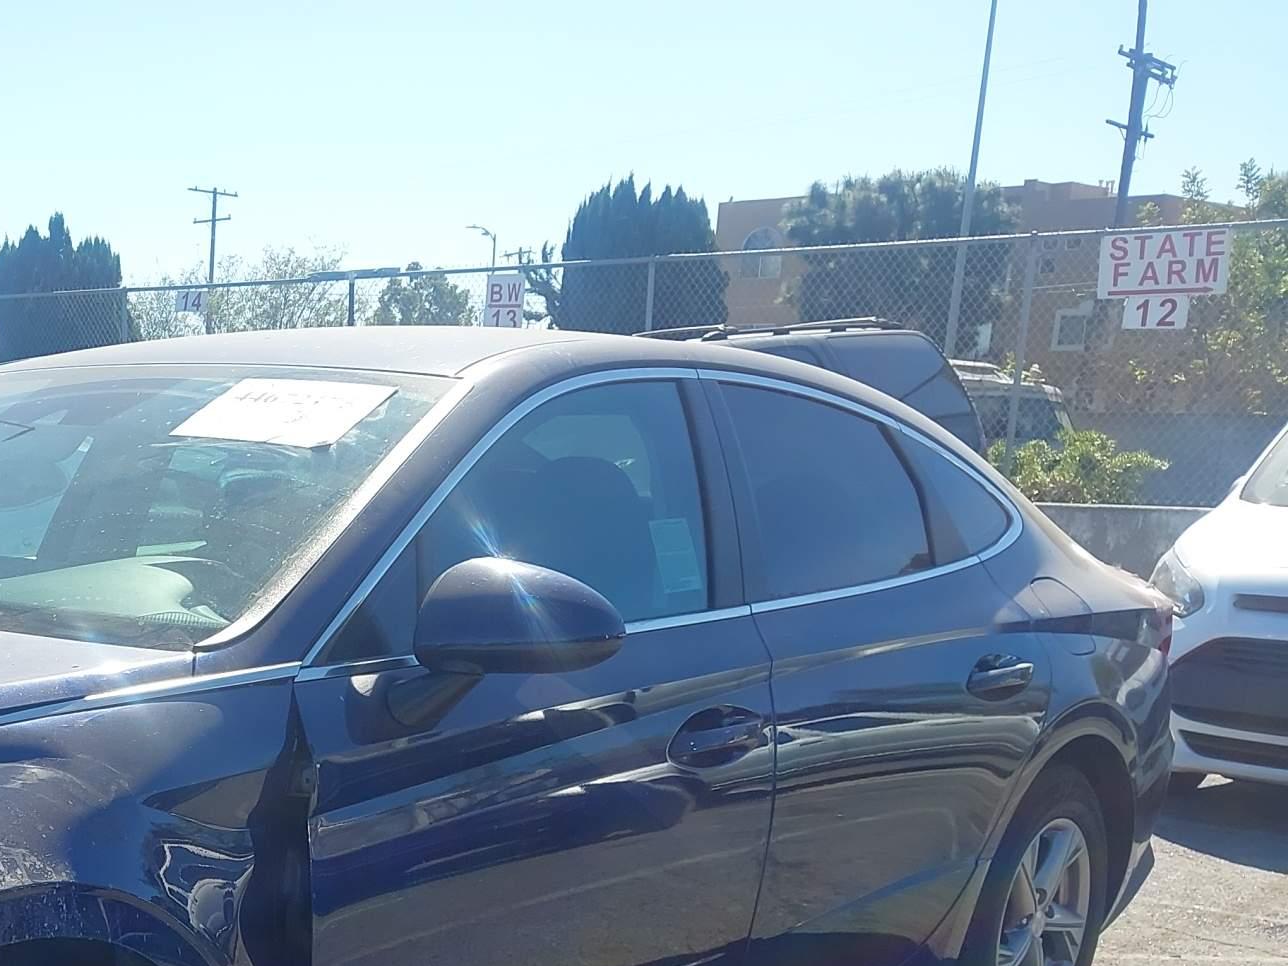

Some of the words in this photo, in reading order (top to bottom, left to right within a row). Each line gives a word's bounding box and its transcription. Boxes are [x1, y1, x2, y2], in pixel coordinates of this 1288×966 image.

[1109, 229, 1227, 261] STATE
[1112, 257, 1220, 288] FARM
[182, 291, 202, 311] 14
[490, 282, 522, 303] BW
[491, 308, 517, 328] 13
[1135, 297, 1178, 328] 12
